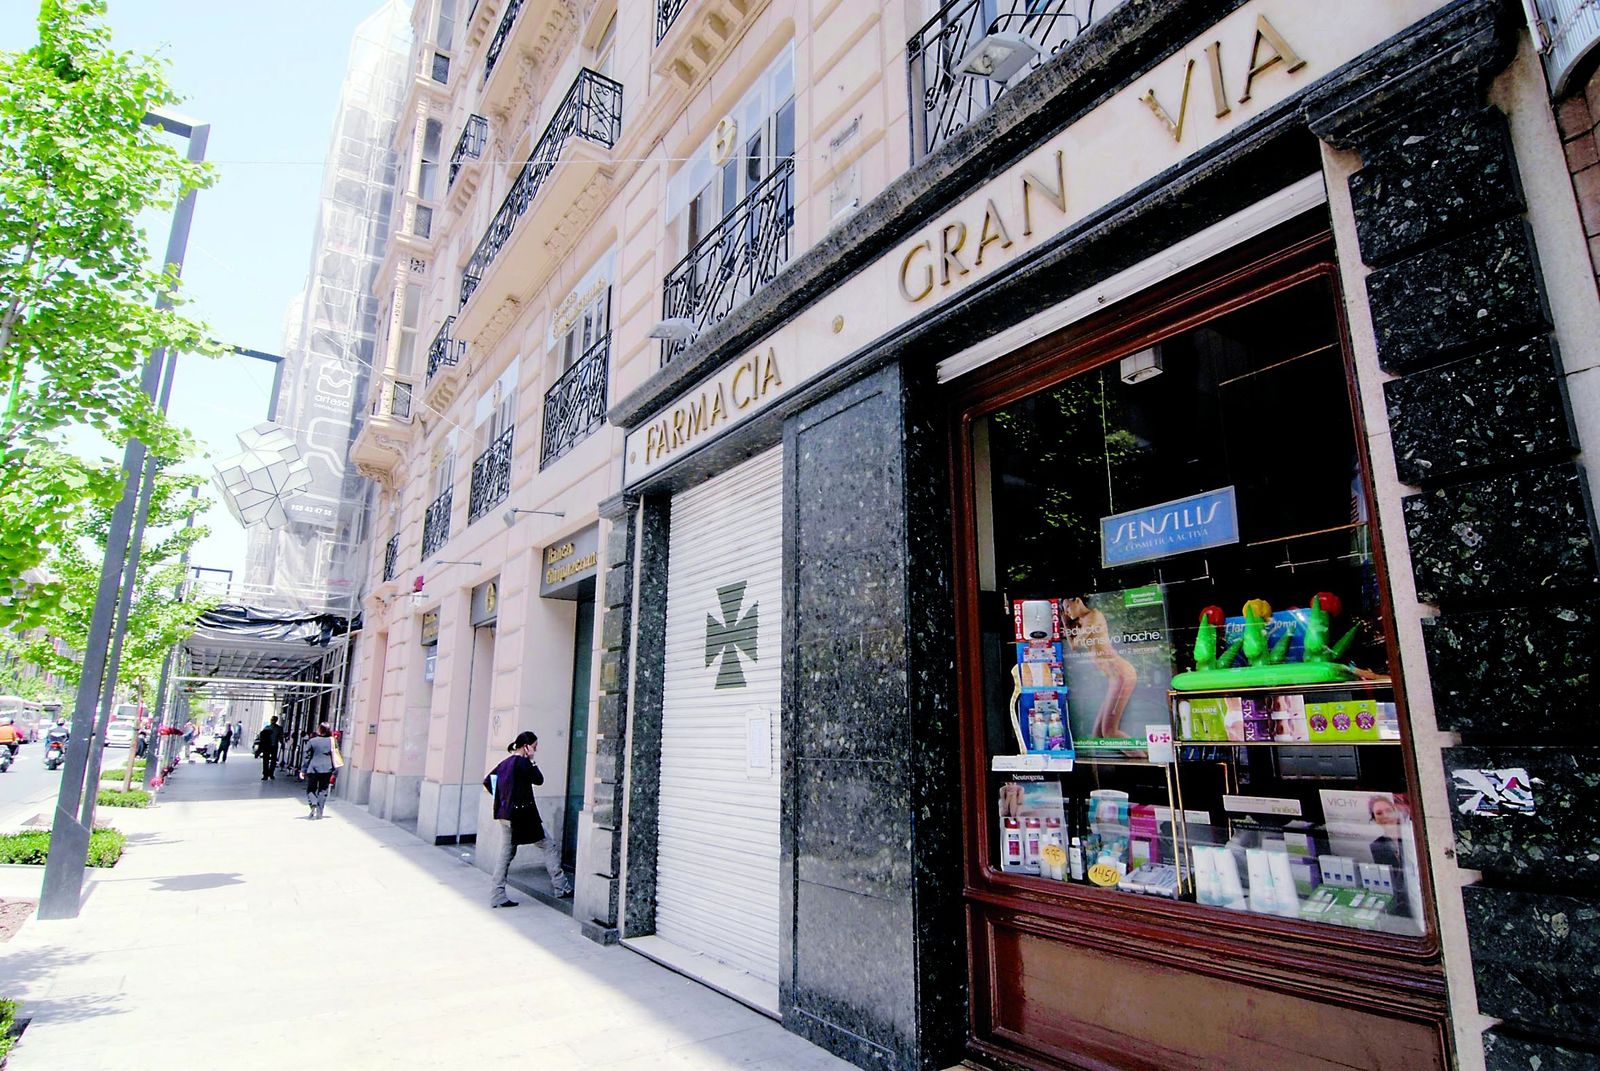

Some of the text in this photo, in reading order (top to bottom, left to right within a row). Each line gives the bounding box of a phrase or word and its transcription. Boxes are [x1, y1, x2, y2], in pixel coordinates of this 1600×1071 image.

[644, 13, 1308, 465] FARMACIA GRAN VIA
[1111, 501, 1222, 544] SENSILIS
[1014, 603, 1023, 640] GRATIS
[1051, 602, 1060, 639] GRATIS
[1073, 630, 1163, 648] Intensvo noche.
[1012, 773, 1045, 782] Neutrogena
[1326, 798, 1358, 808] VICHY
